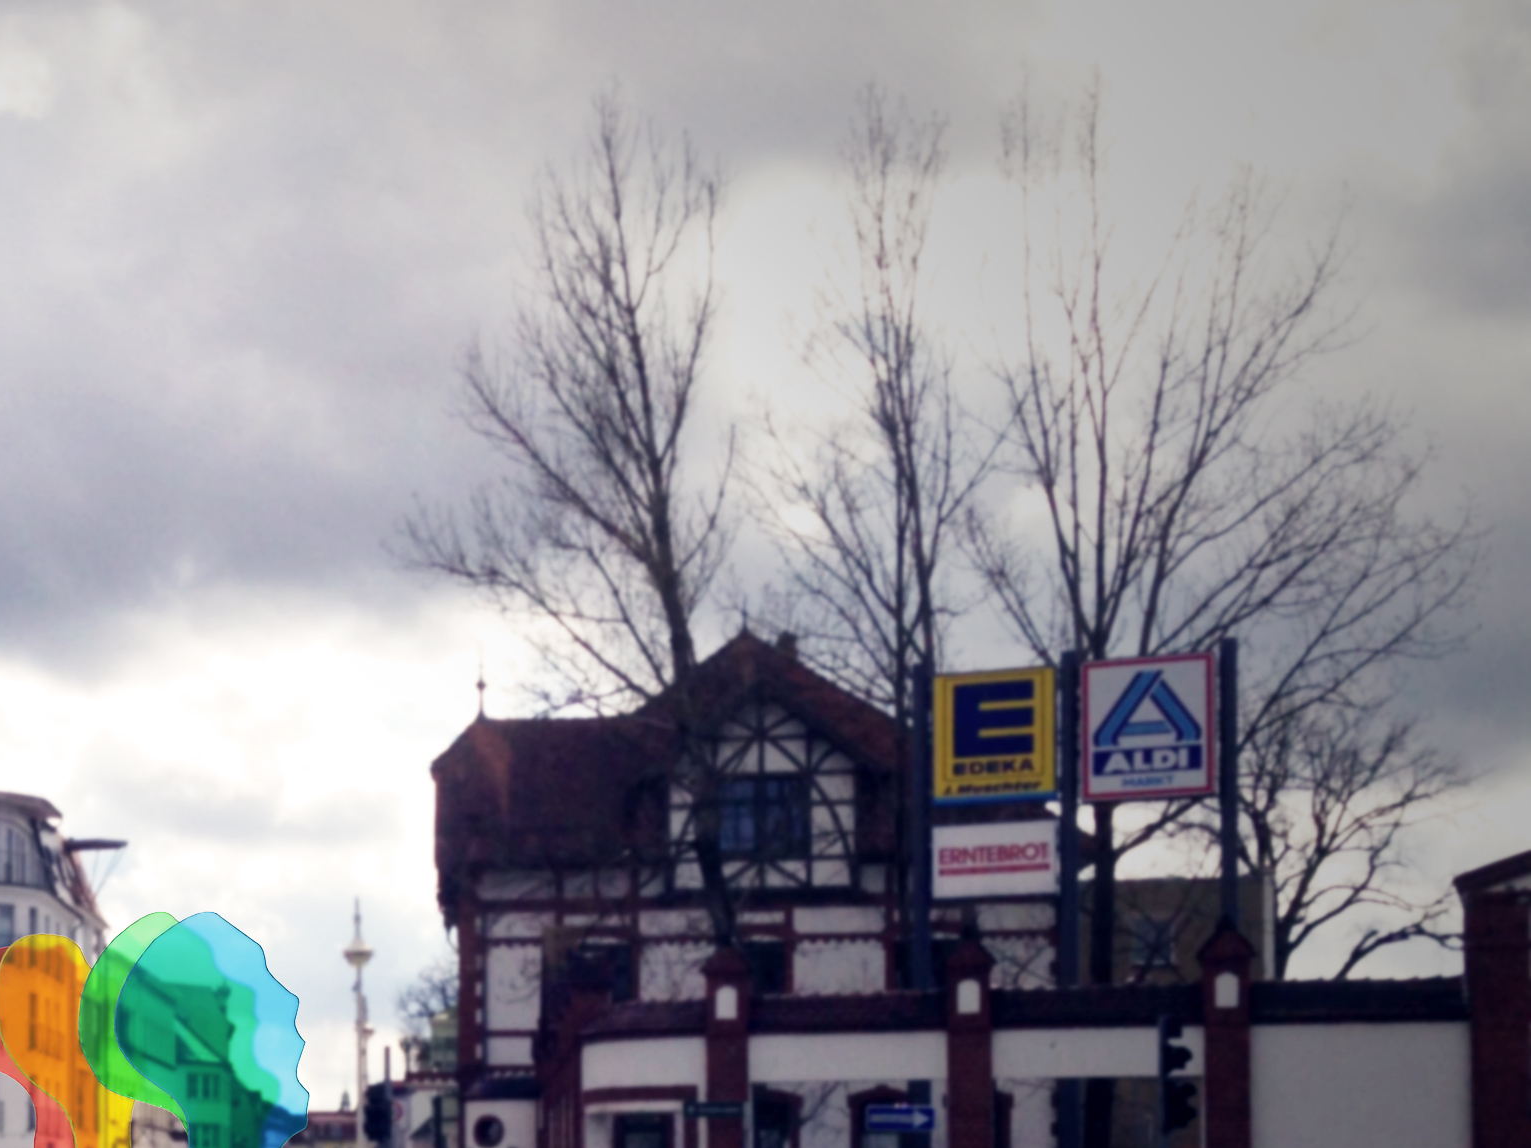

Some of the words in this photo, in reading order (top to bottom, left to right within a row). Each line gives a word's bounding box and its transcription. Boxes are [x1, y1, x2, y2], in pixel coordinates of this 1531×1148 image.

[953, 758, 1034, 776] EDEKA
[1103, 748, 1189, 774] ALDI
[938, 843, 1049, 865] ERNTEBROT
